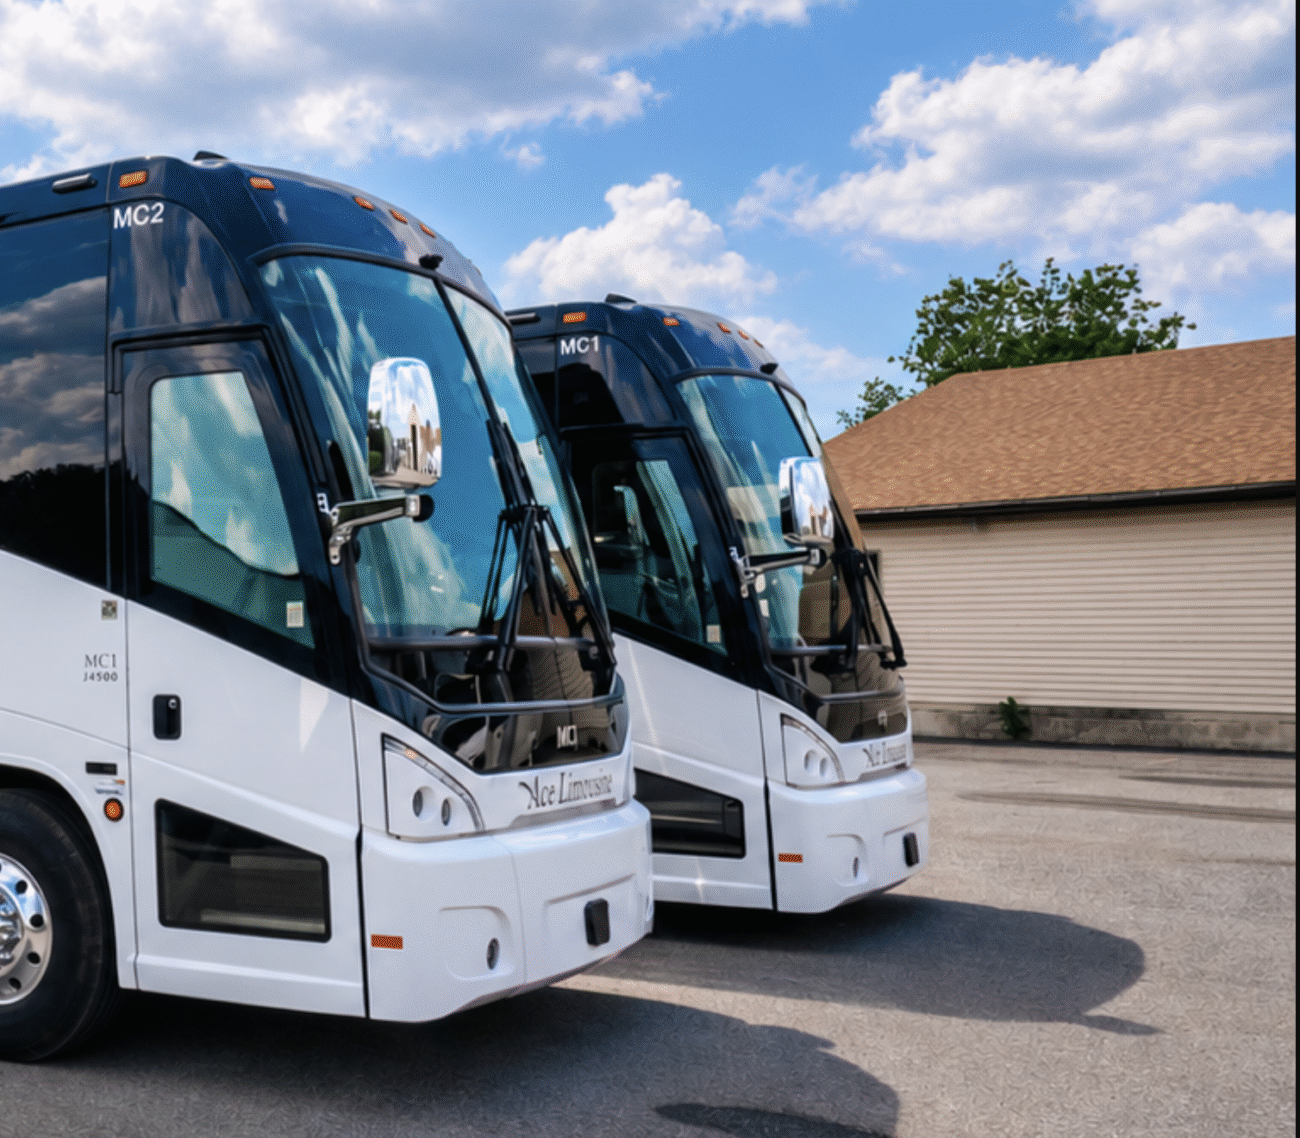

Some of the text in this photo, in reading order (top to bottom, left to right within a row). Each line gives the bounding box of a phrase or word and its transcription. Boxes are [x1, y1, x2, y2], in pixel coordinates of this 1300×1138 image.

[113, 202, 164, 229] MC2
[560, 335, 599, 356] MC1
[83, 671, 118, 682] J4500
